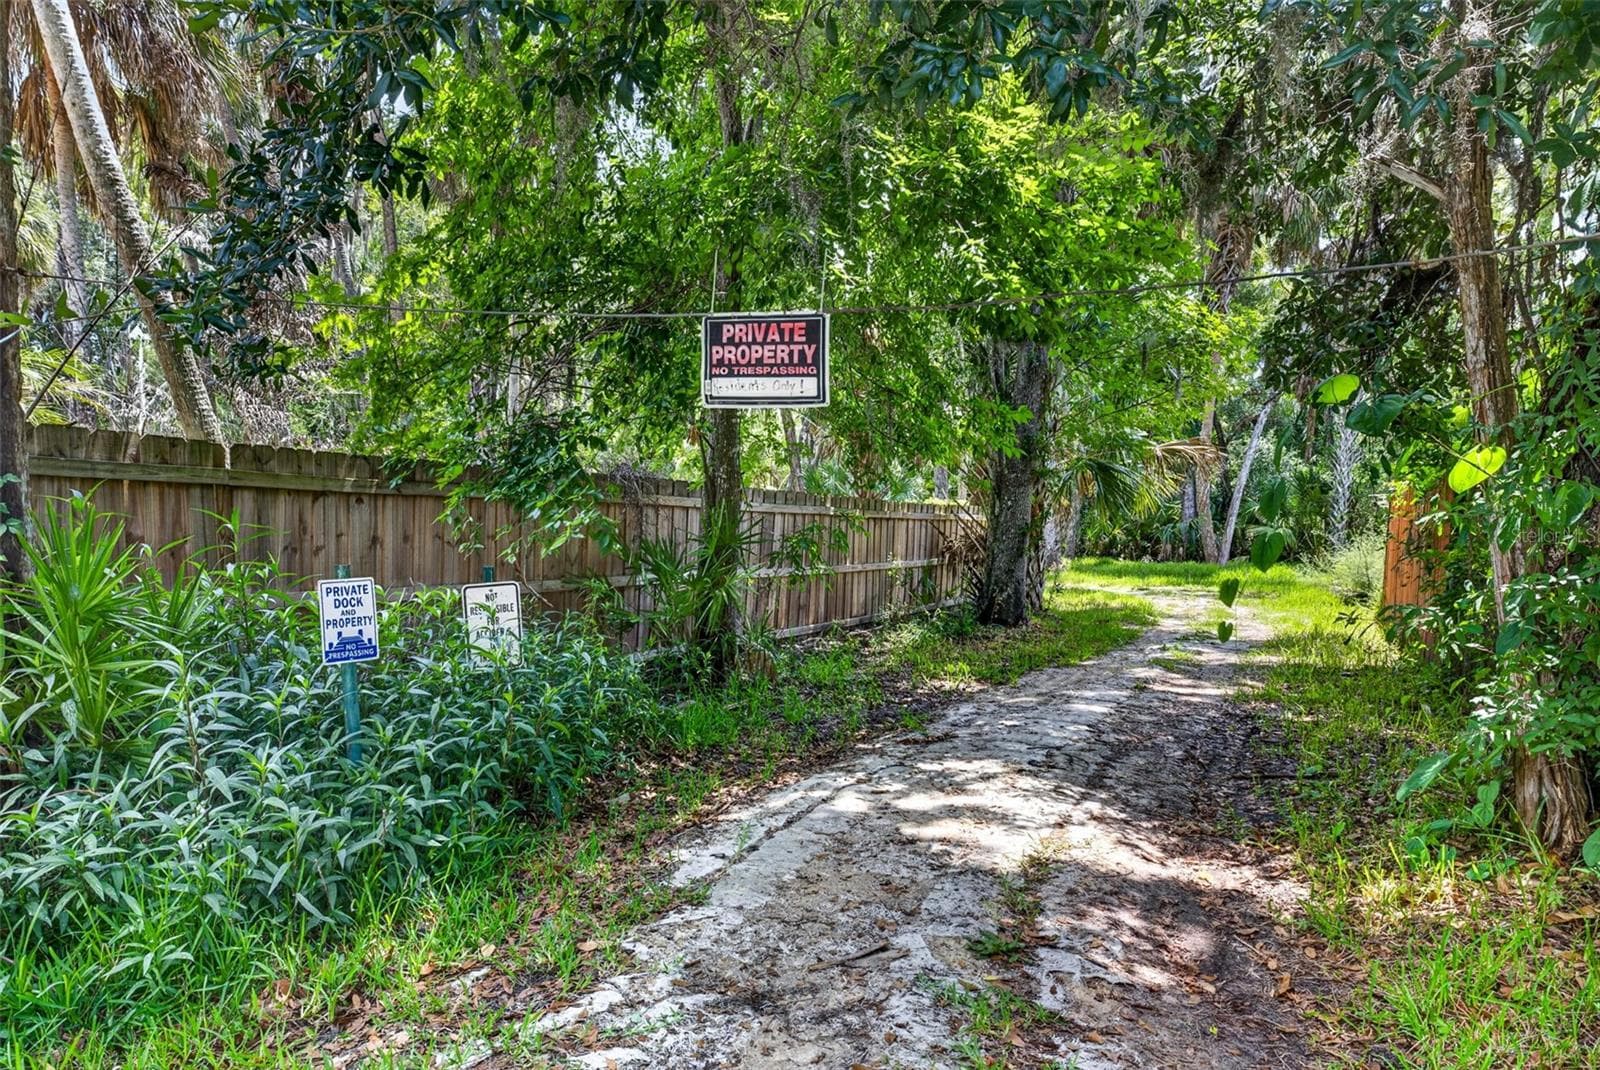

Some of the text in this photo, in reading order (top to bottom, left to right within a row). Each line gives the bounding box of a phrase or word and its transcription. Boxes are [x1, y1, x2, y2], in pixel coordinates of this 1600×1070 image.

[721, 322, 807, 343] PRIVATE
[711, 344, 817, 365] PROPERTY
[711, 366, 817, 375] NO TRESPASSING
[325, 584, 369, 597] PRIVATE
[333, 596, 364, 609] DOCK
[484, 592, 498, 602] NOT
[340, 608, 357, 617] AND
[325, 615, 373, 629] PROPERTY
[345, 642, 357, 651] NO
[328, 648, 375, 659] TRESPASSING
